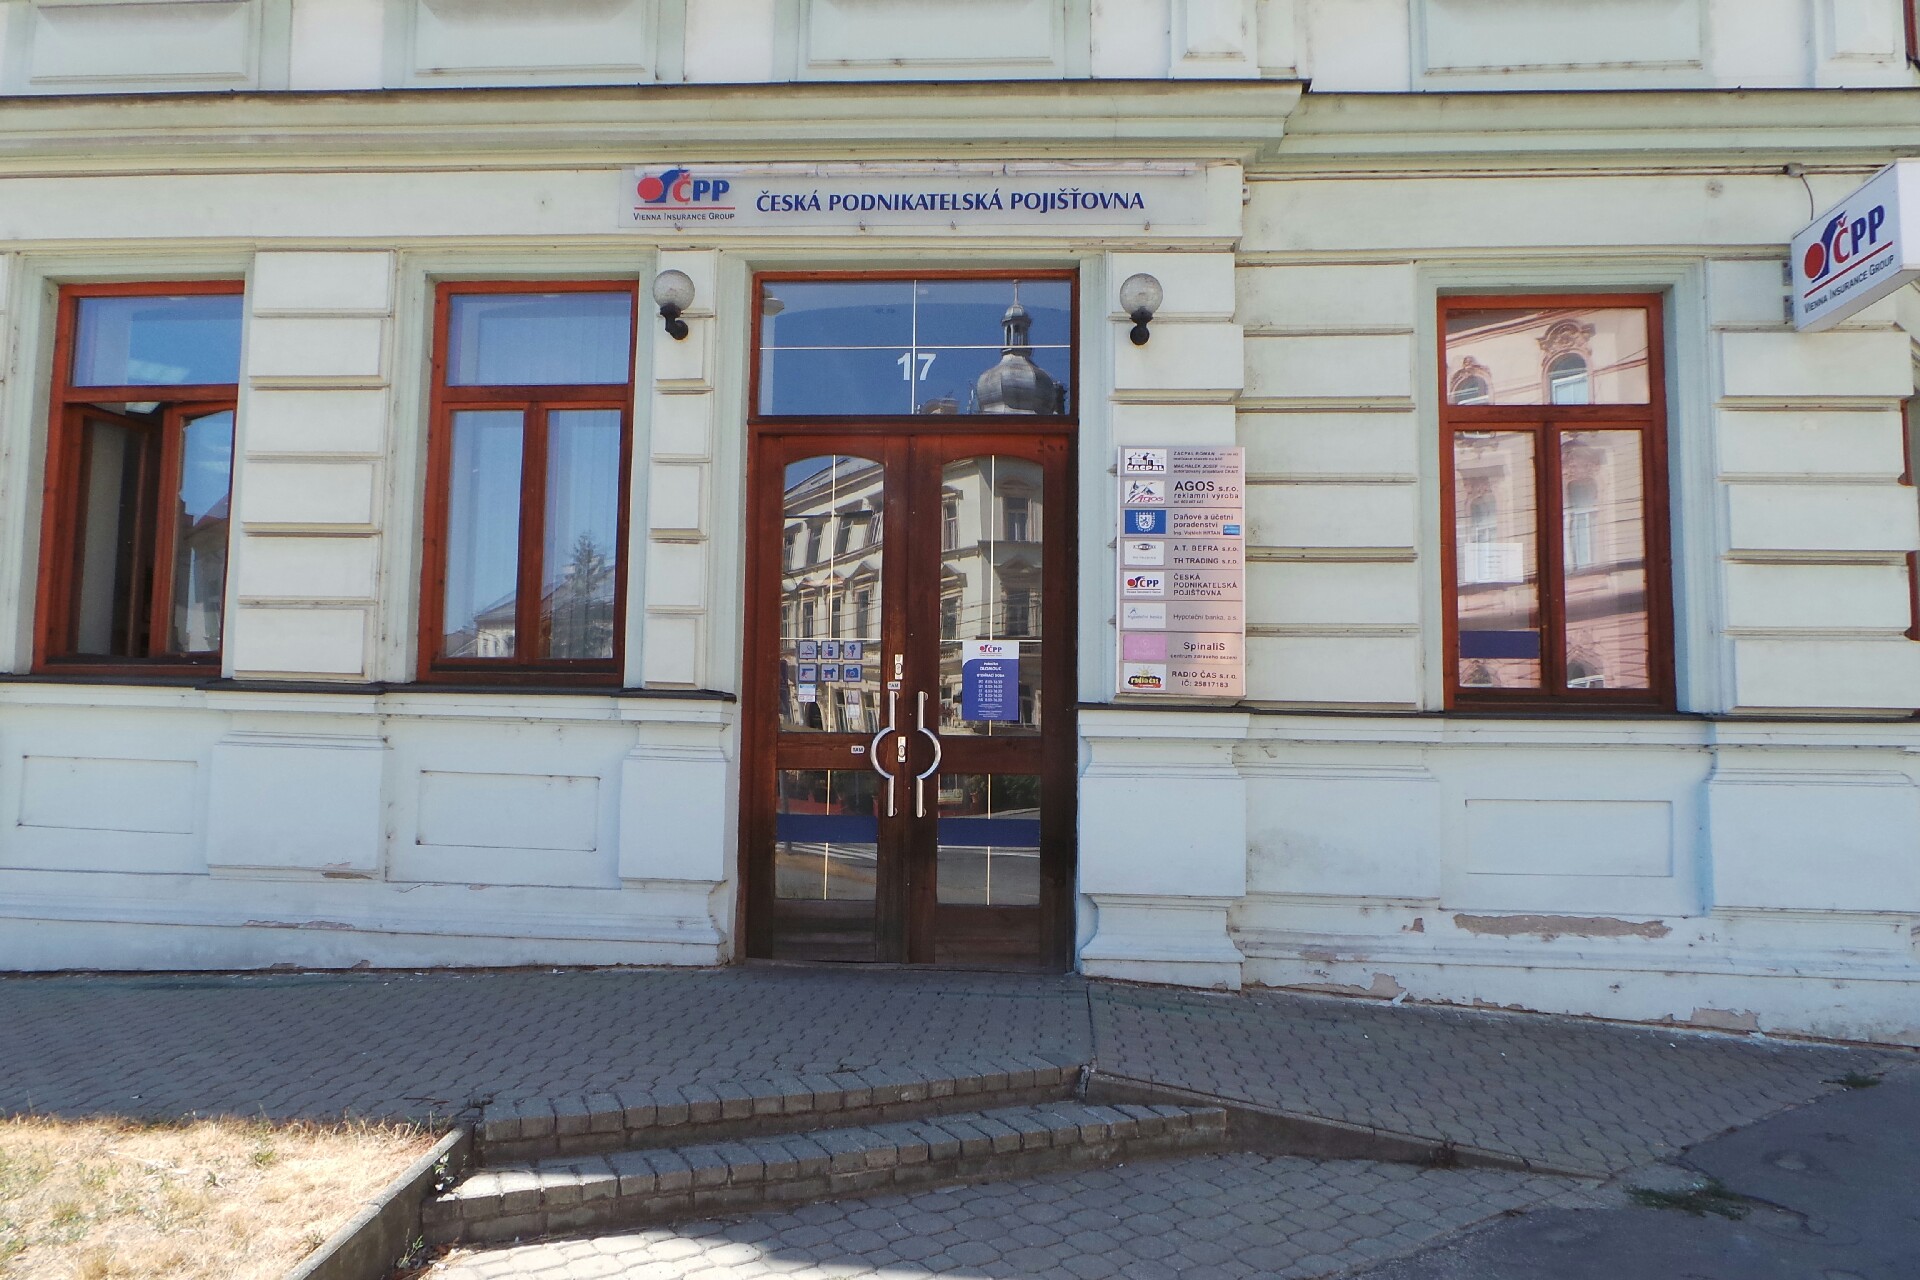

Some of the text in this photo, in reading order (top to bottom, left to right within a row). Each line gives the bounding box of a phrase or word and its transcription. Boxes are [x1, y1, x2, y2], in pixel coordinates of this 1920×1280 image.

[672, 173, 730, 203] ČPP
[756, 188, 1145, 214] ČESKÁ PODNIKATELSKÁ POJIŠŤOVNA
[1833, 205, 1886, 264] ČPP
[897, 353, 937, 381] 17
[1174, 481, 1215, 492] AGOS
[1140, 576, 1159, 588] ČPP
[1184, 642, 1225, 652] SpinaliS
[1200, 670, 1217, 678] ČAS
